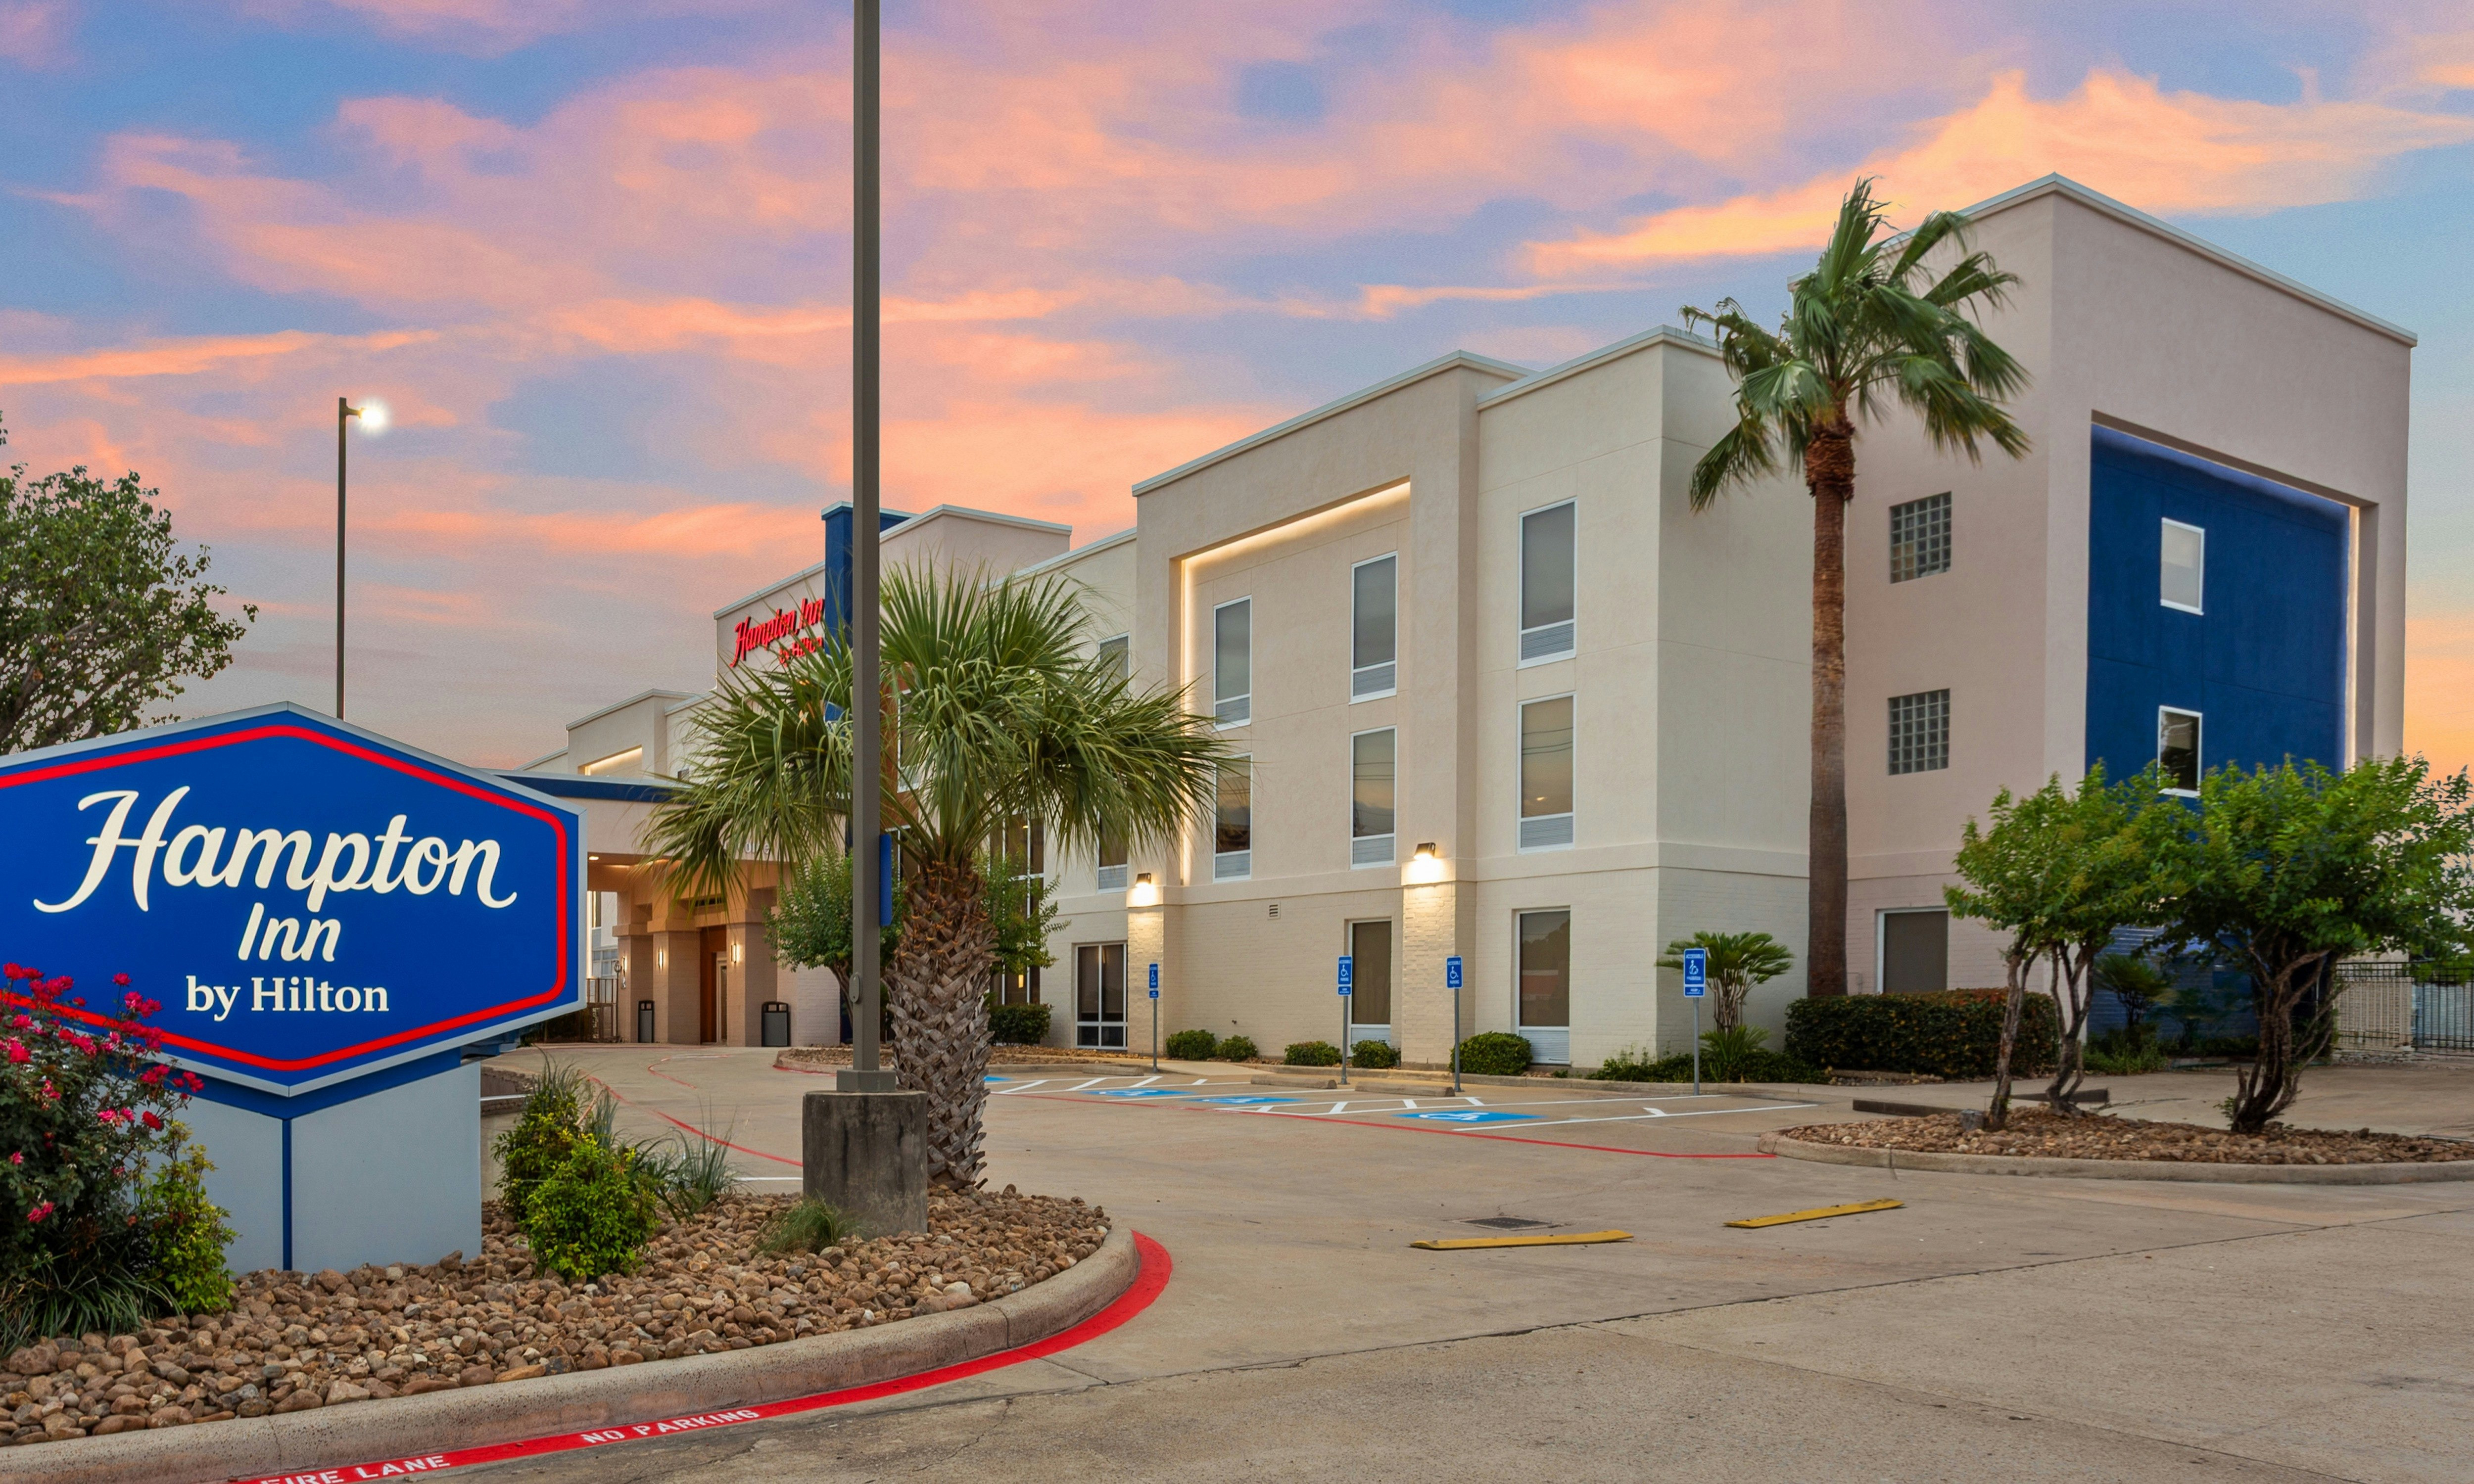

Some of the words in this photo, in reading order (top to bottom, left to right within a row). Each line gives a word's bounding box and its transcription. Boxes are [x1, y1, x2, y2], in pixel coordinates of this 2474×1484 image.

[729, 608, 800, 668] Hampton
[800, 598, 824, 629] Inn
[33, 786, 518, 913] Hampton
[238, 902, 341, 962] Inn
[186, 975, 240, 1022] by
[251, 976, 389, 1012] Hilton
[581, 1430, 625, 1444] NO
[632, 1409, 760, 1436] PARKING
[355, 1455, 450, 1479] LANE
